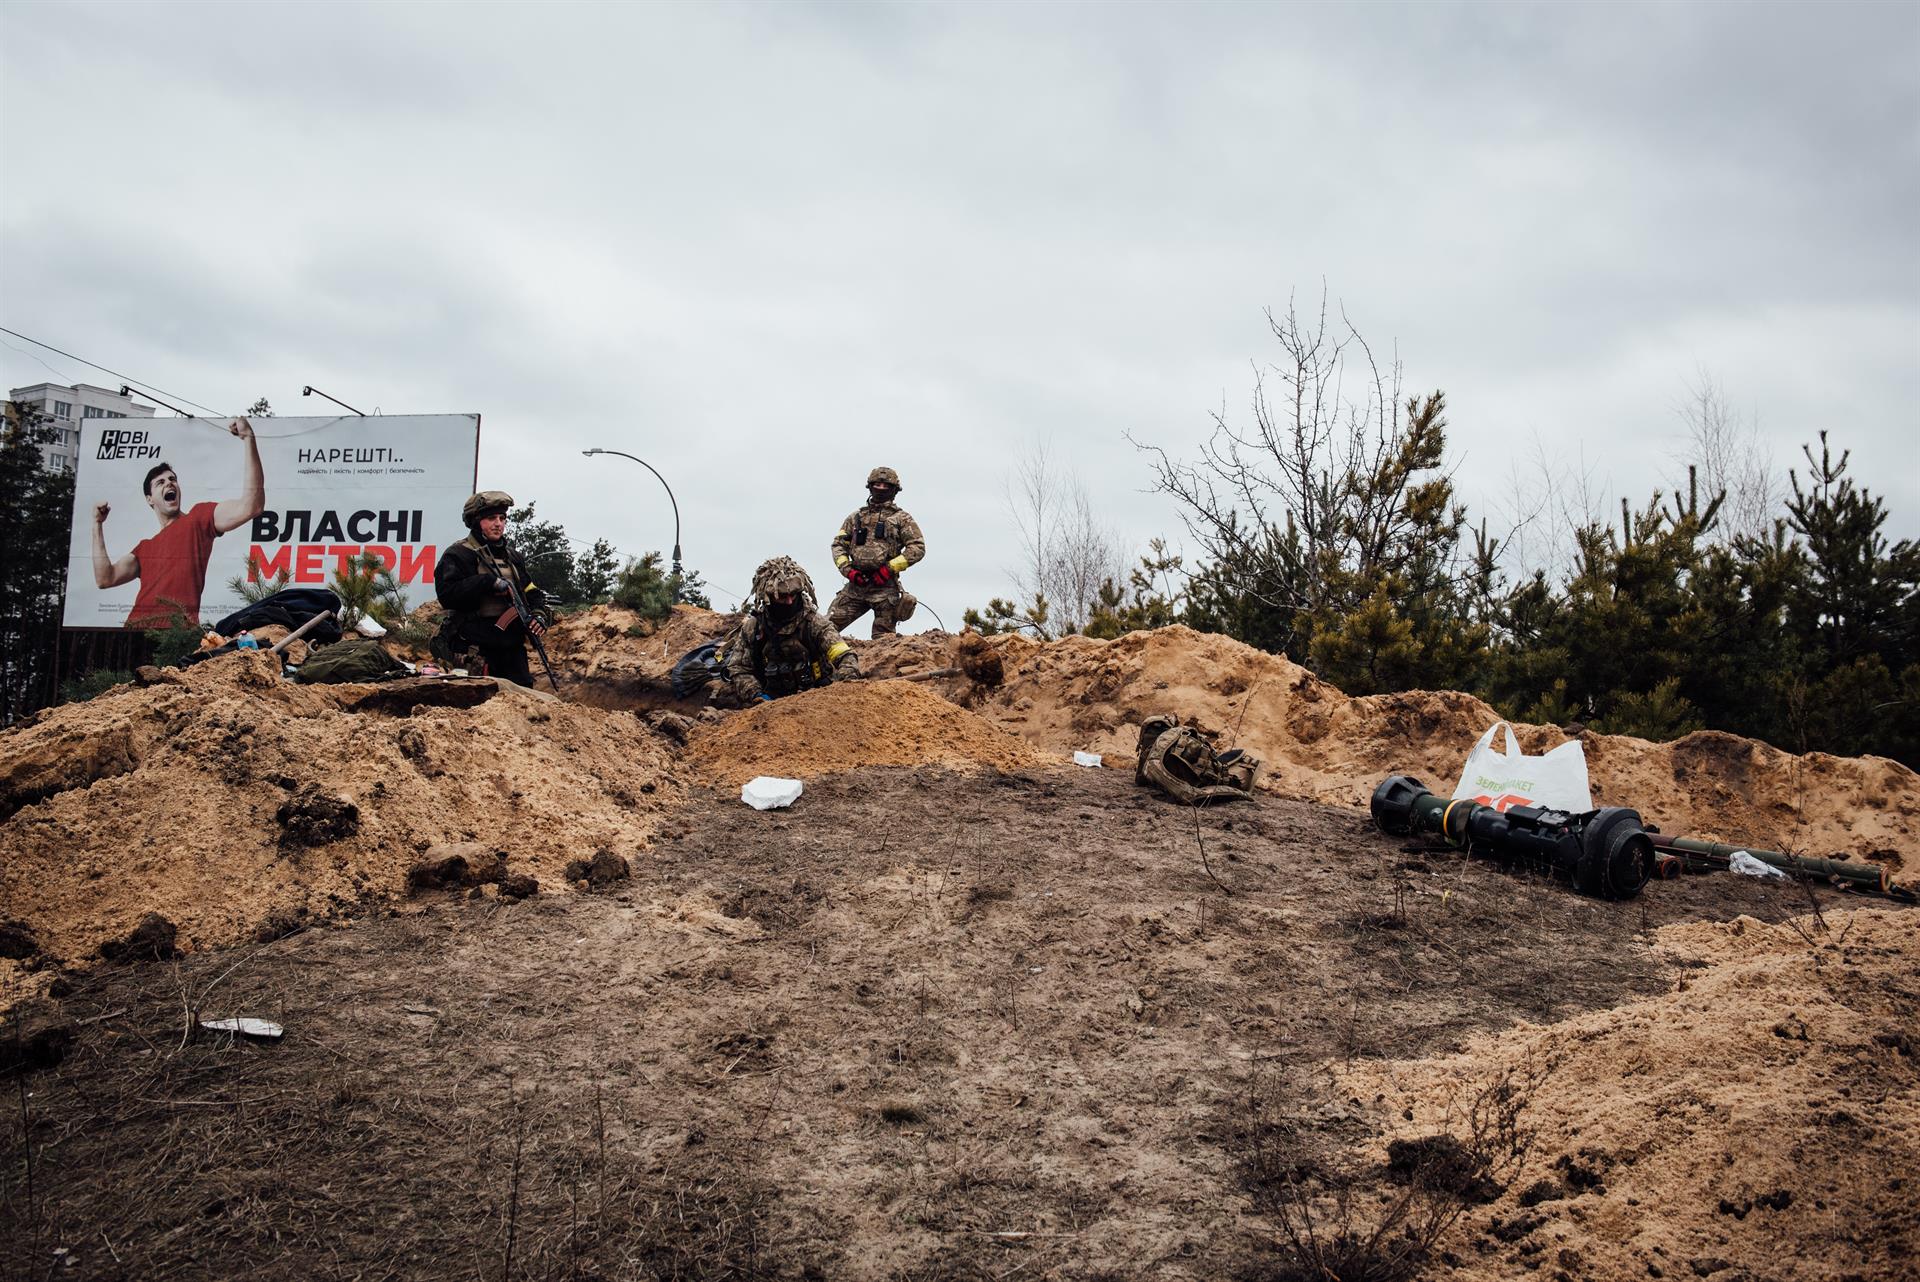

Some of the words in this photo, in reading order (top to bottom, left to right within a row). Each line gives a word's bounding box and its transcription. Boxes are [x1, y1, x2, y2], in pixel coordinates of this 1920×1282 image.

[102, 430, 149, 444] НОВІ
[97, 445, 161, 459] МЕТРИ
[298, 448, 403, 463] НАРЕШТІ..
[297, 467, 327, 475] надійність
[358, 467, 383, 475] комфорт
[250, 510, 423, 543] ВЛАСНІ
[247, 544, 437, 584] МЕТРИ
